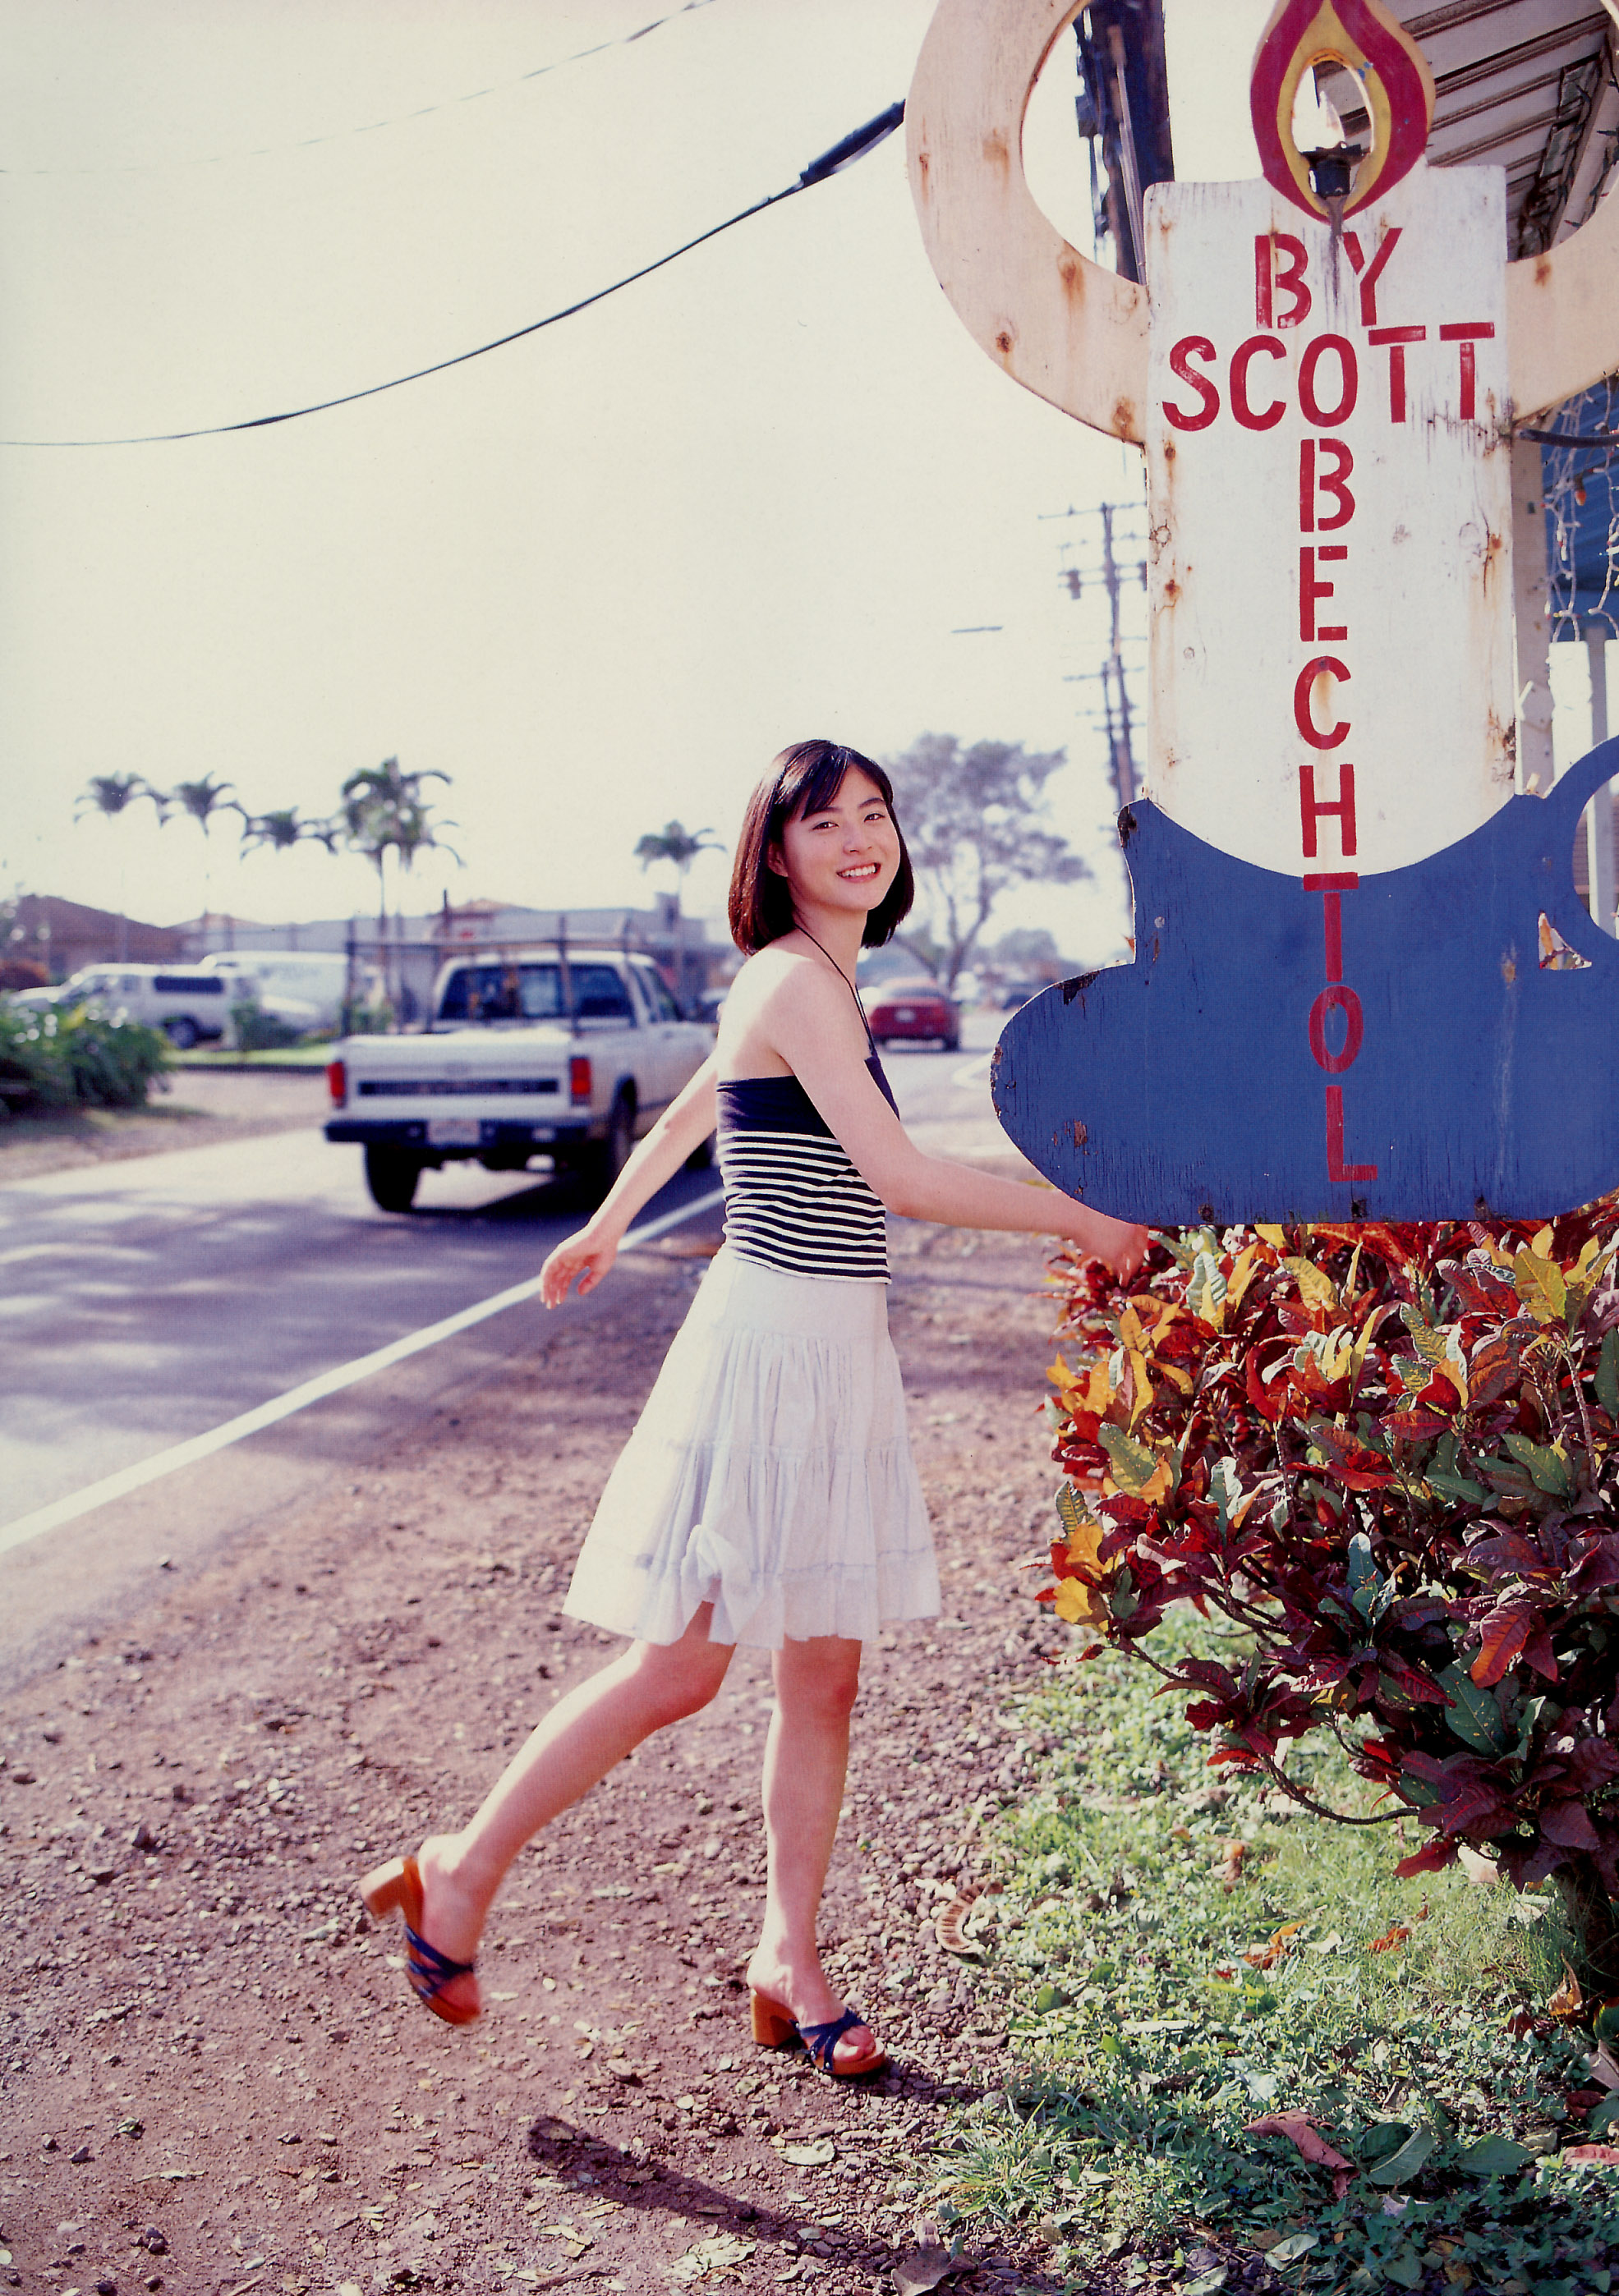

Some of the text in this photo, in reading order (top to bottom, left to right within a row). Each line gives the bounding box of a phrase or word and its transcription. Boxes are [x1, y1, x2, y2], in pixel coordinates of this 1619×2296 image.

[1255, 227, 1403, 328] BY
[1161, 322, 1495, 431] SCOTT
[1294, 438, 1378, 1182] BECHTOL
